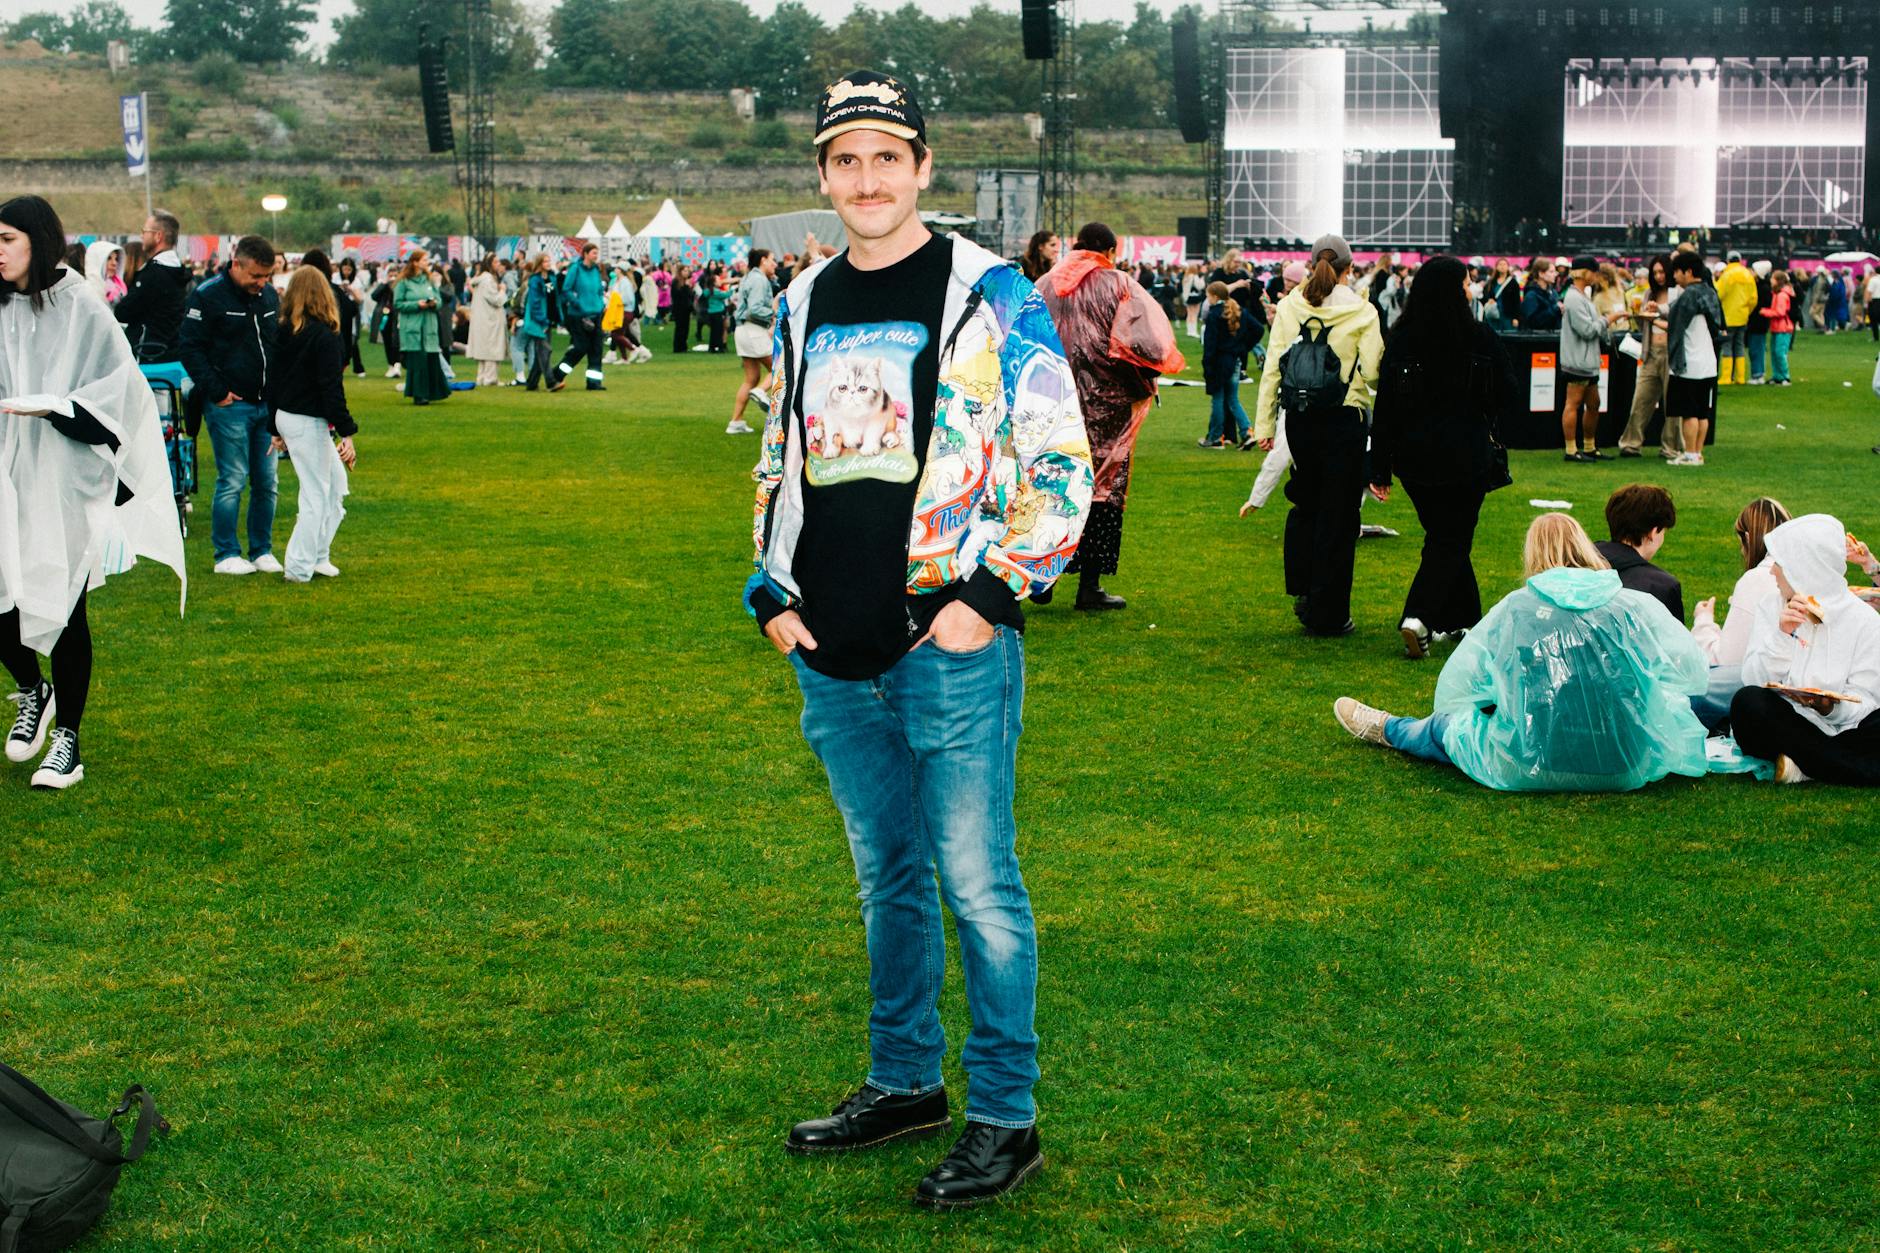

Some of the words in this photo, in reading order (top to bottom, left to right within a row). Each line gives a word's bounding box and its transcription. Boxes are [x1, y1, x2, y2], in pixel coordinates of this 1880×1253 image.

[822, 106, 857, 125] ANDREW
[806, 329, 838, 352] It's
[838, 329, 882, 355] super
[885, 329, 919, 345] cute
